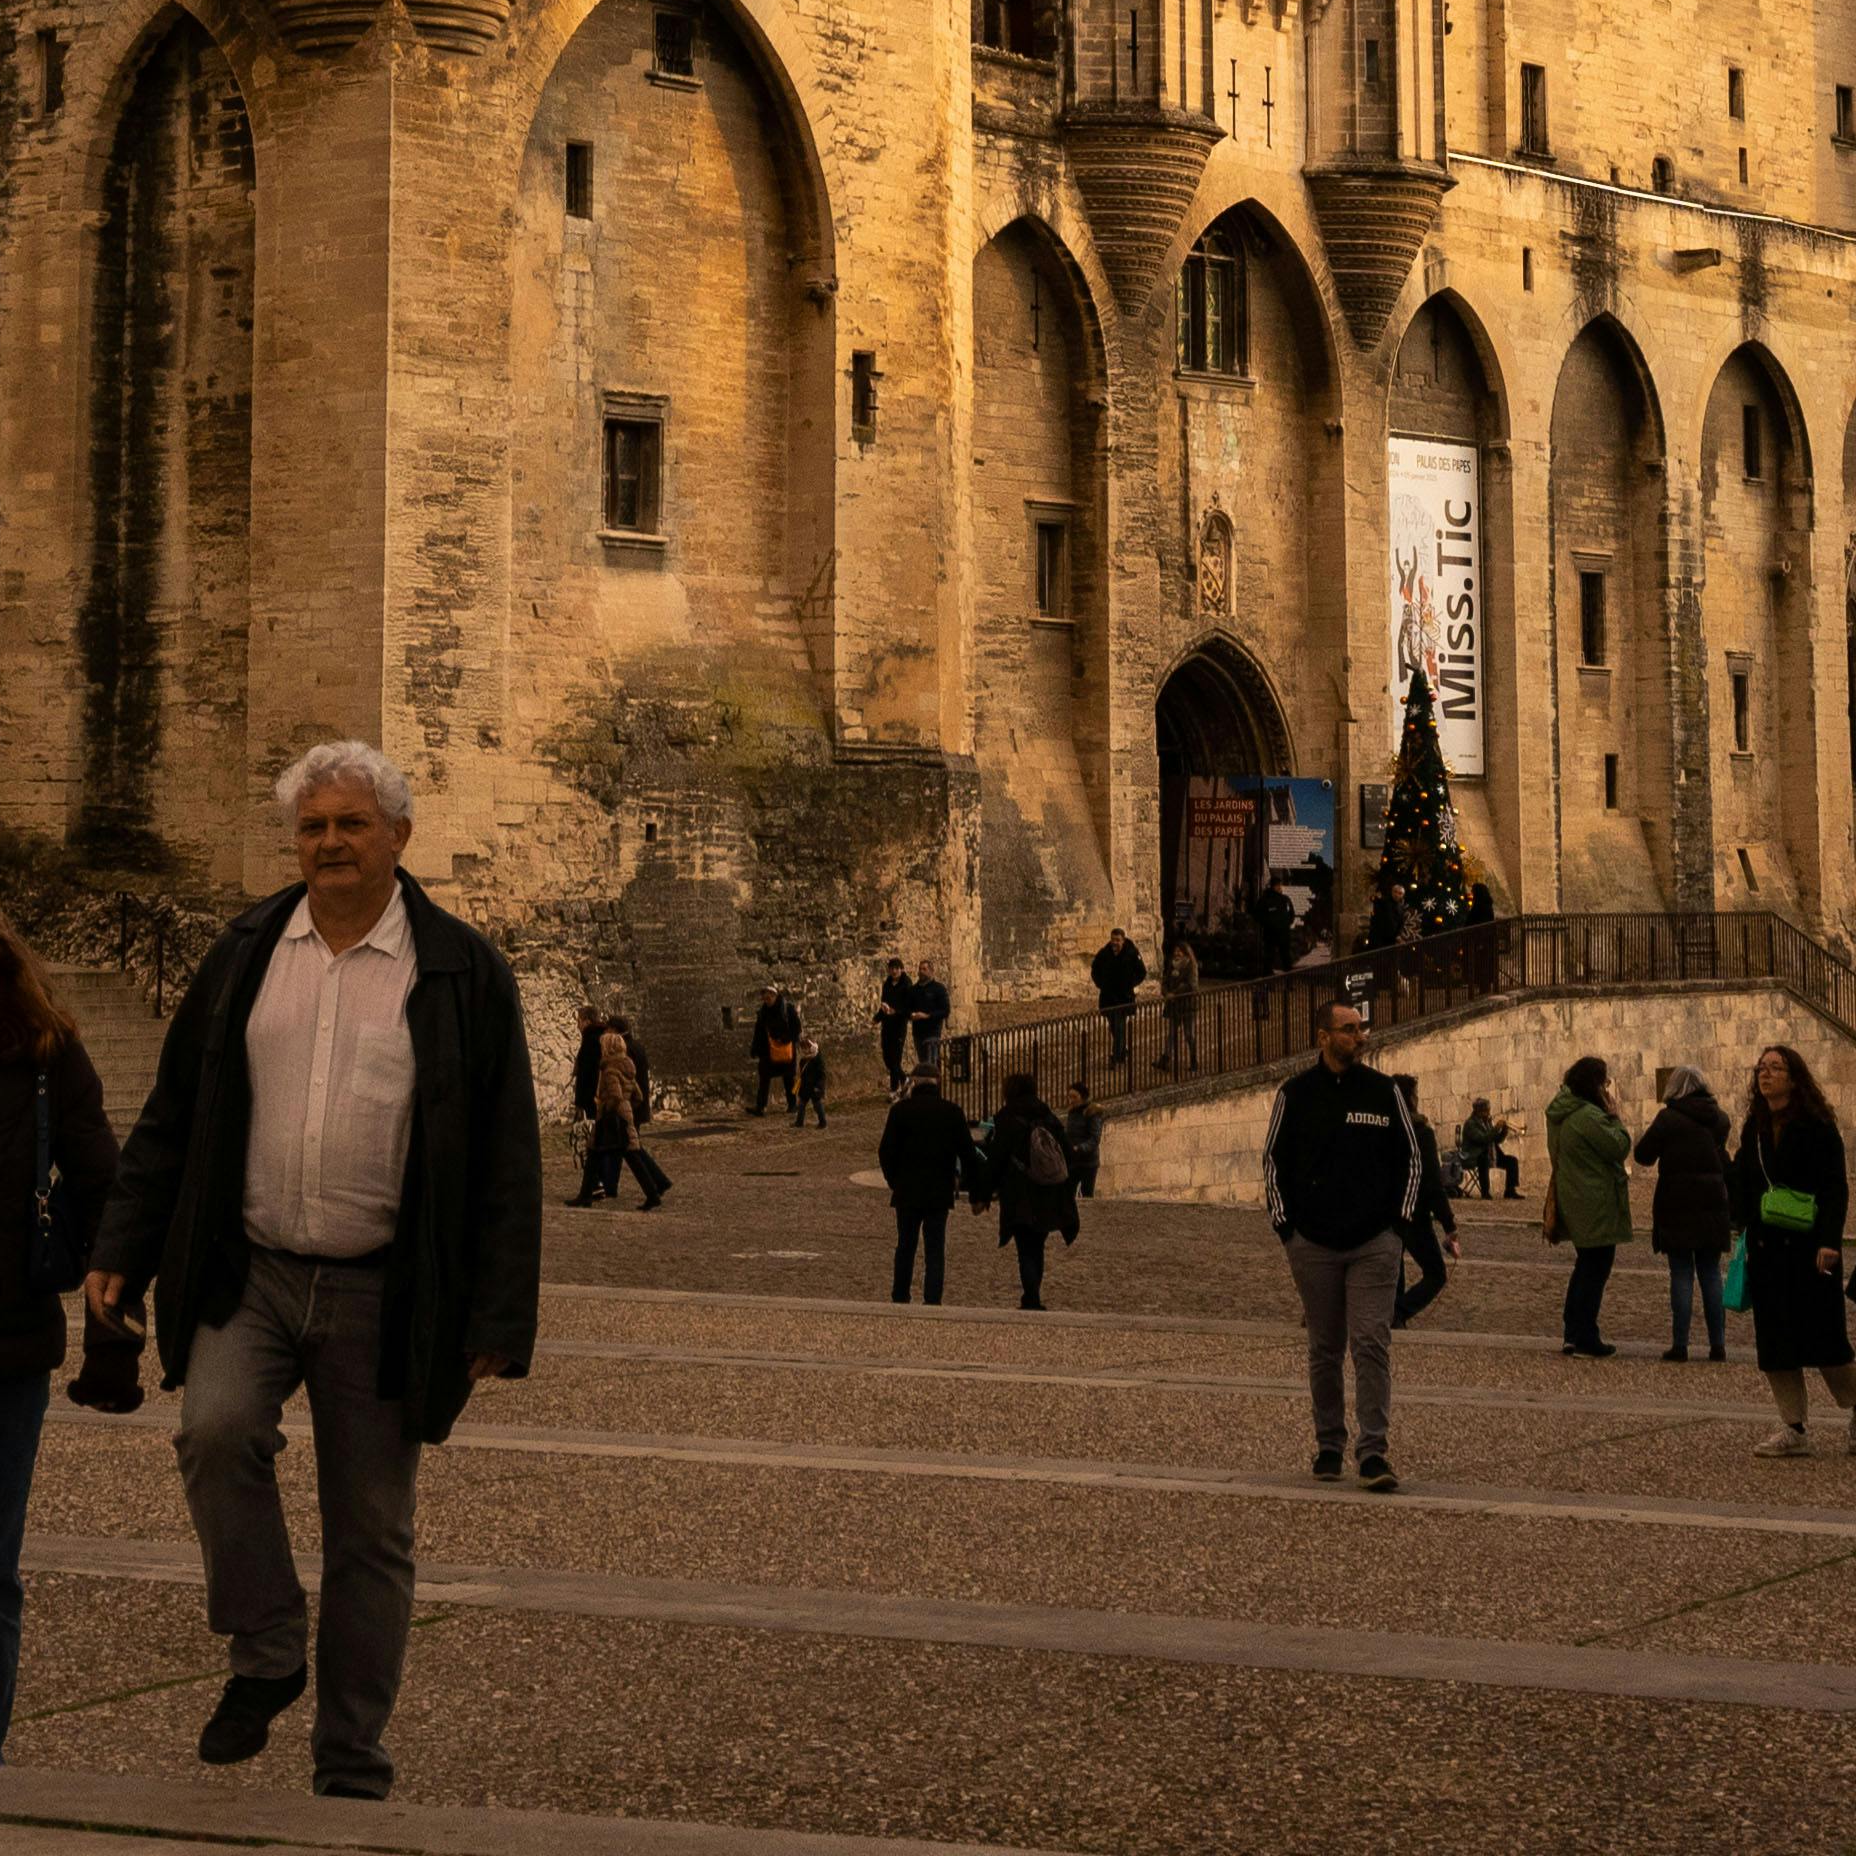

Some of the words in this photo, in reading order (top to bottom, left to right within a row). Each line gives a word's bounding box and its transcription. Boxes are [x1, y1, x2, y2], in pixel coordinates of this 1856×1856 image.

[1417, 454, 1437, 470] PALAIS
[1438, 457, 1451, 471] DES
[1452, 458, 1471, 473] PAPES
[1194, 800, 1212, 810] LES
[1214, 800, 1254, 810] JARDINS
[1194, 813, 1207, 823] DU
[1210, 813, 1242, 824] PALAIS
[1194, 826, 1212, 836] DES
[1215, 826, 1245, 837] PAPES
[1346, 1112, 1389, 1127] ADIDAS
